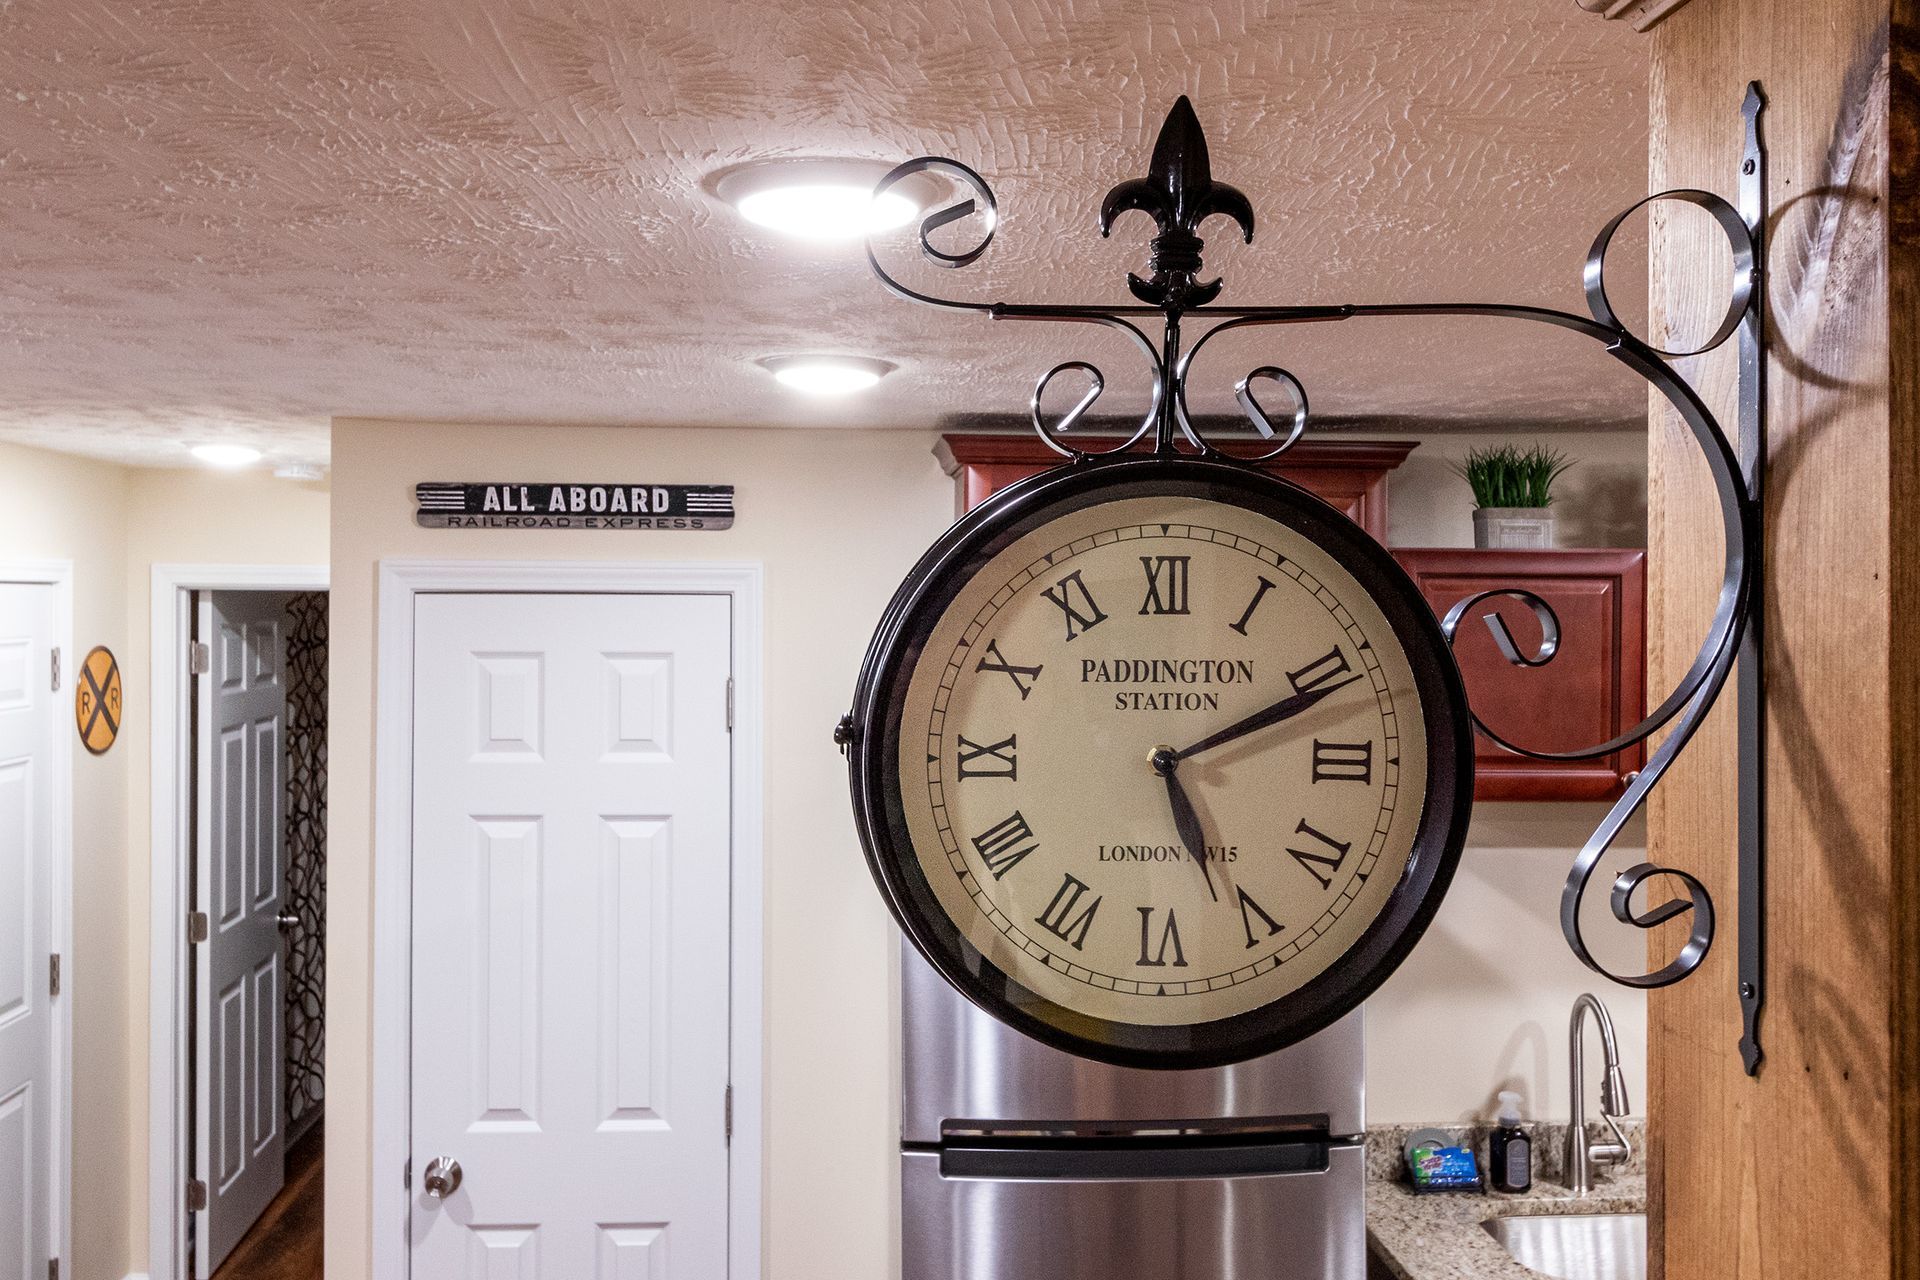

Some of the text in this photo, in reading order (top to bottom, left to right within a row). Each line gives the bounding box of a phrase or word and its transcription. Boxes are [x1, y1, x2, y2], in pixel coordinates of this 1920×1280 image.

[483, 487, 670, 513] ALL ABOARD
[448, 517, 704, 529] RAILROAD EXPRESS
[1138, 556, 1191, 615] XII
[1040, 569, 1108, 642] XI
[975, 639, 1043, 701] X
[1081, 659, 1254, 684] PADDINGTON
[82, 691, 91, 715] R
[1115, 692, 1219, 711] STATION
[958, 734, 1017, 782] IX
[1312, 738, 1372, 785] III
[1099, 845, 1181, 862] LONDON
[1136, 907, 1188, 967] VI
